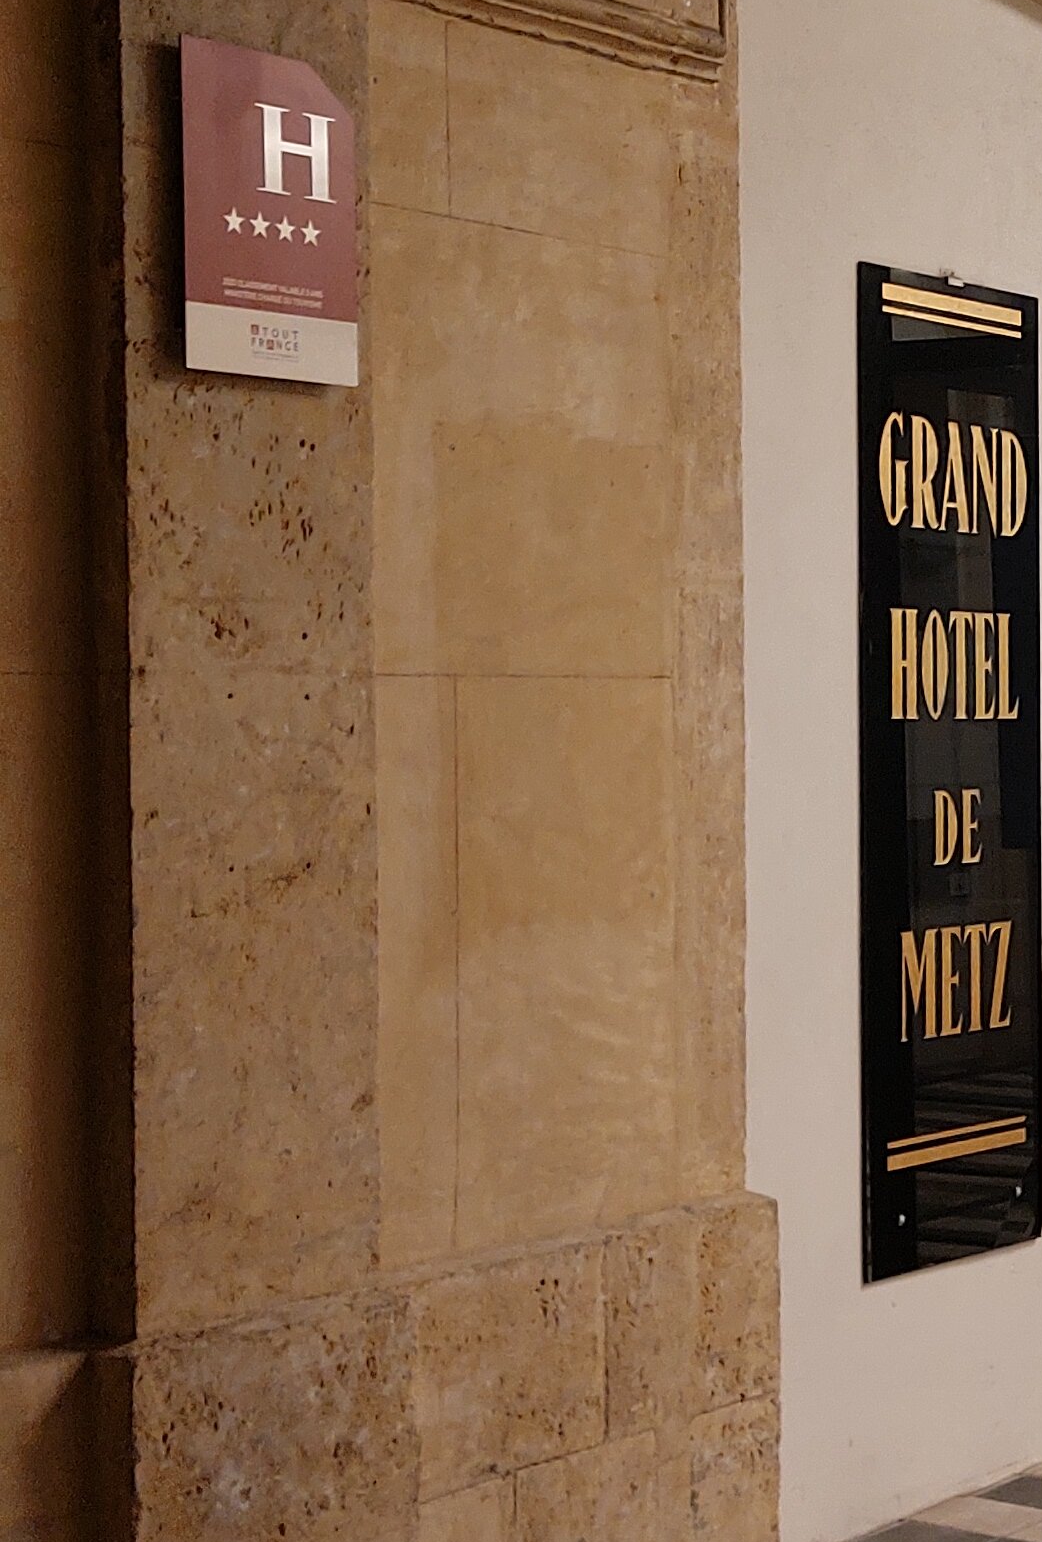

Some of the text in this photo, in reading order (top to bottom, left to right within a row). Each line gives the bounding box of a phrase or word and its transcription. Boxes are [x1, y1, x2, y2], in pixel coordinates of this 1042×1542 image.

[254, 102, 336, 204] H
[250, 337, 299, 352] FRANCE
[879, 411, 1028, 539] GRAND
[889, 608, 1020, 721] HOTEL
[933, 788, 983, 866] DE
[900, 920, 1012, 1042] METZ
